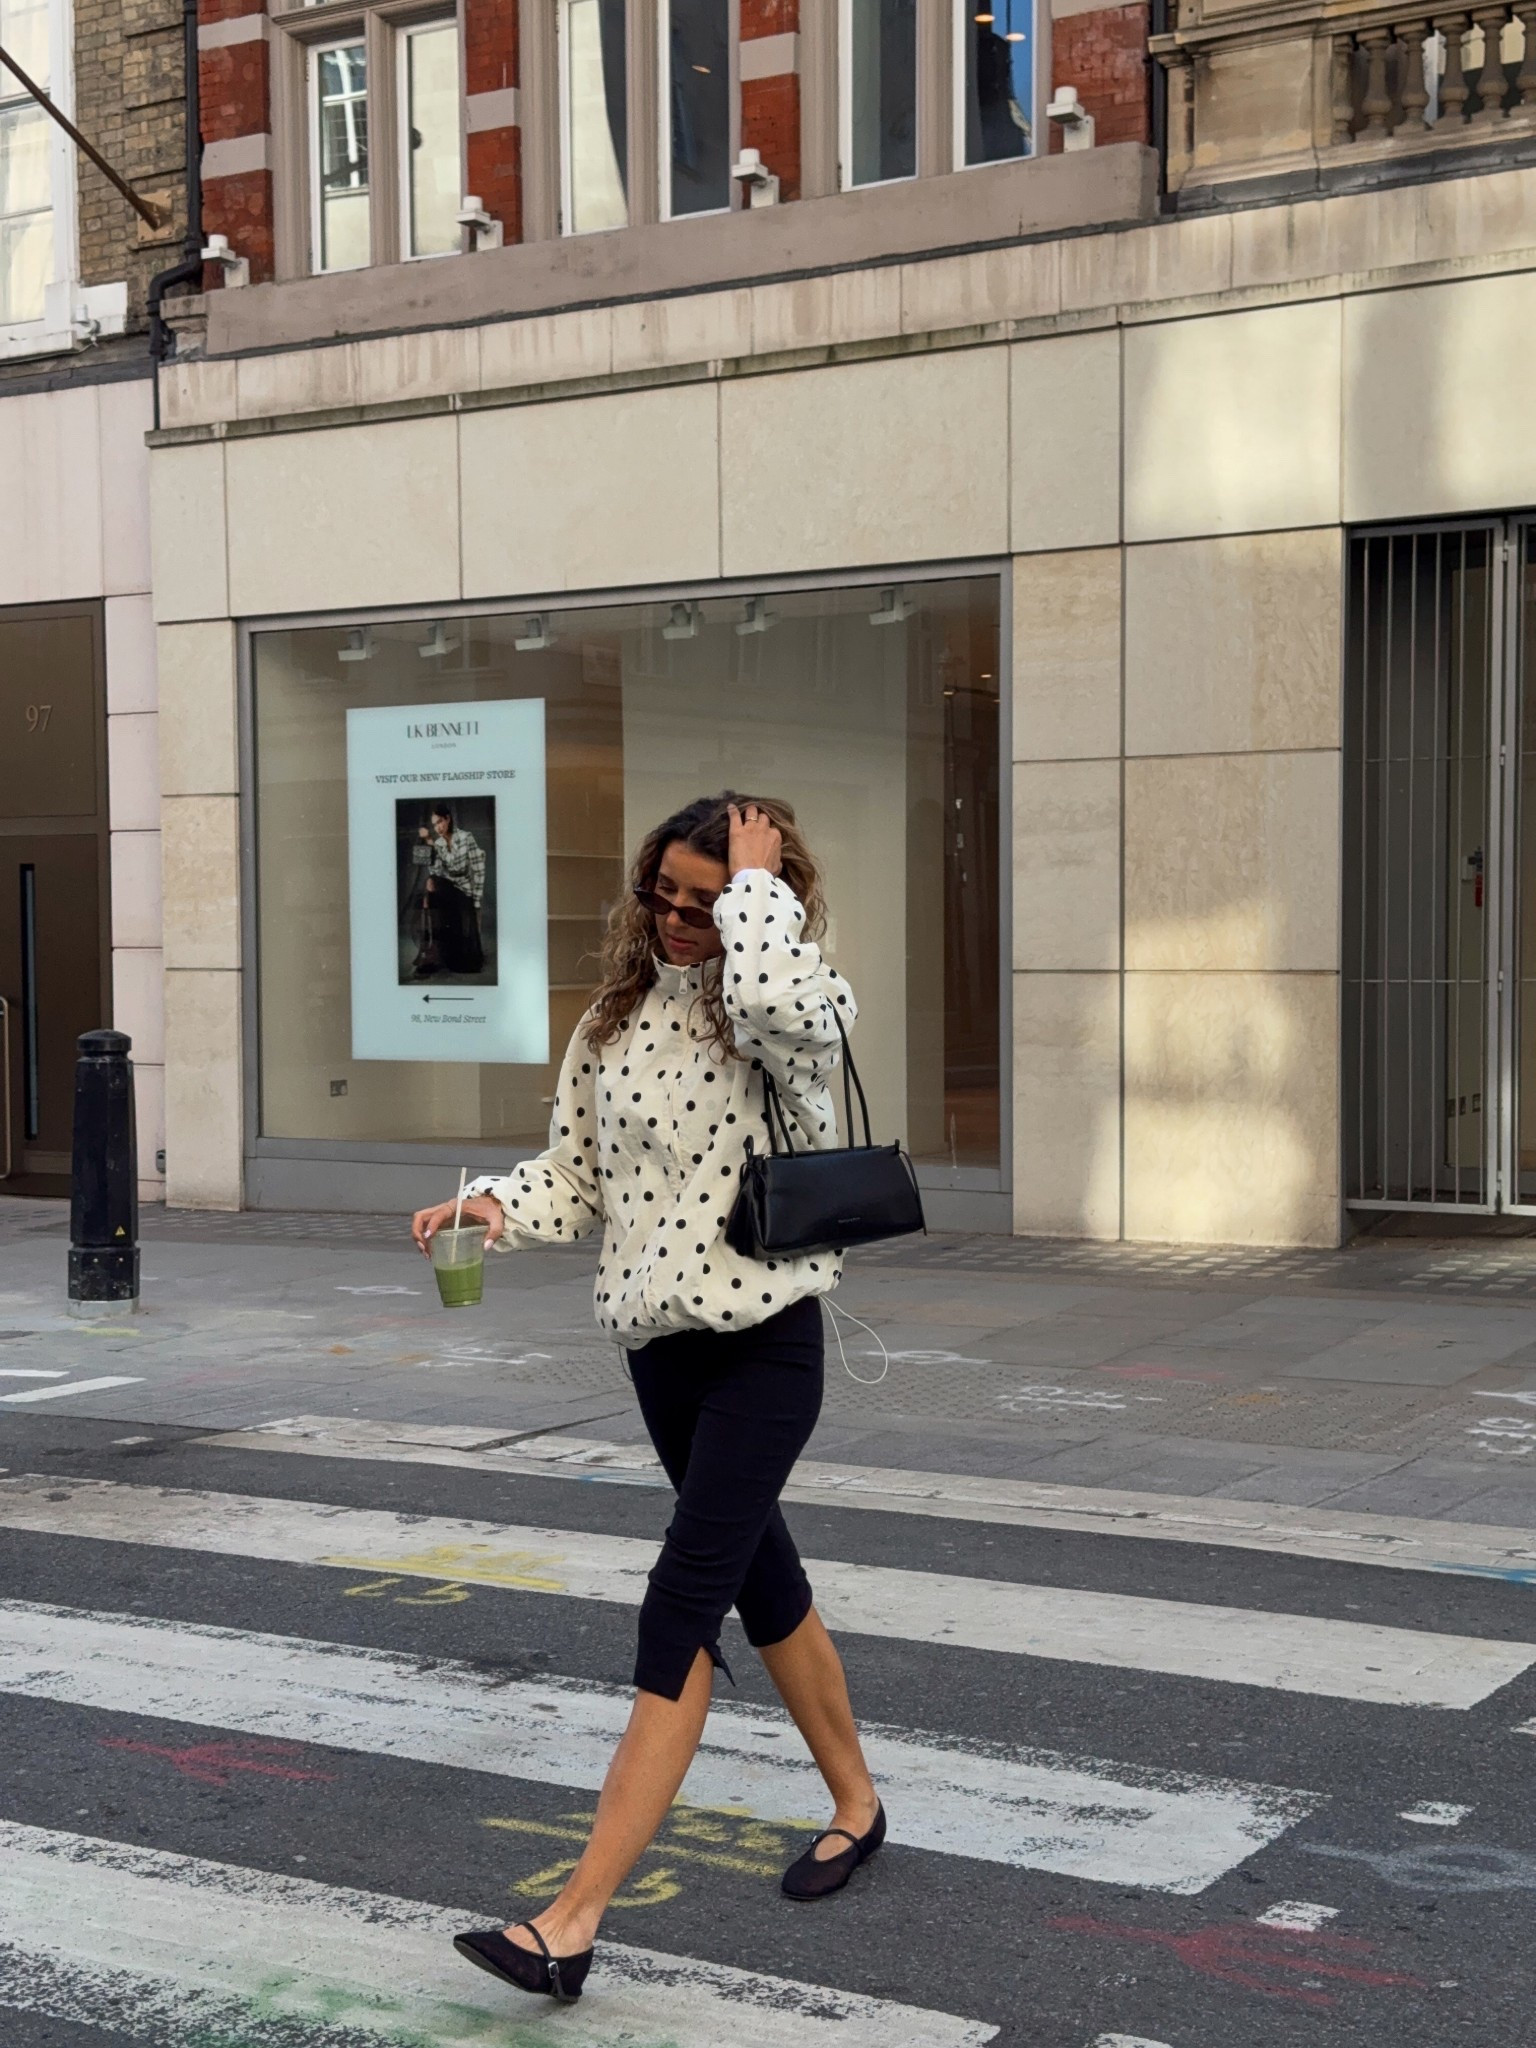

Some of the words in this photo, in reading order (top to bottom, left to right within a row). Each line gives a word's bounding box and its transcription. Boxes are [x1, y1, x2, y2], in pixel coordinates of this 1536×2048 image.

[25, 704, 53, 733] 97
[426, 721, 479, 738] BENNETT
[375, 774, 399, 784] VISIT
[399, 774, 418, 783] OUR
[420, 773, 441, 782] NEW
[442, 771, 485, 781] FLAGSHIP
[486, 769, 516, 779] STORE
[423, 1014, 441, 1024] New
[441, 1013, 462, 1024] Bond
[463, 1014, 487, 1024] Street
